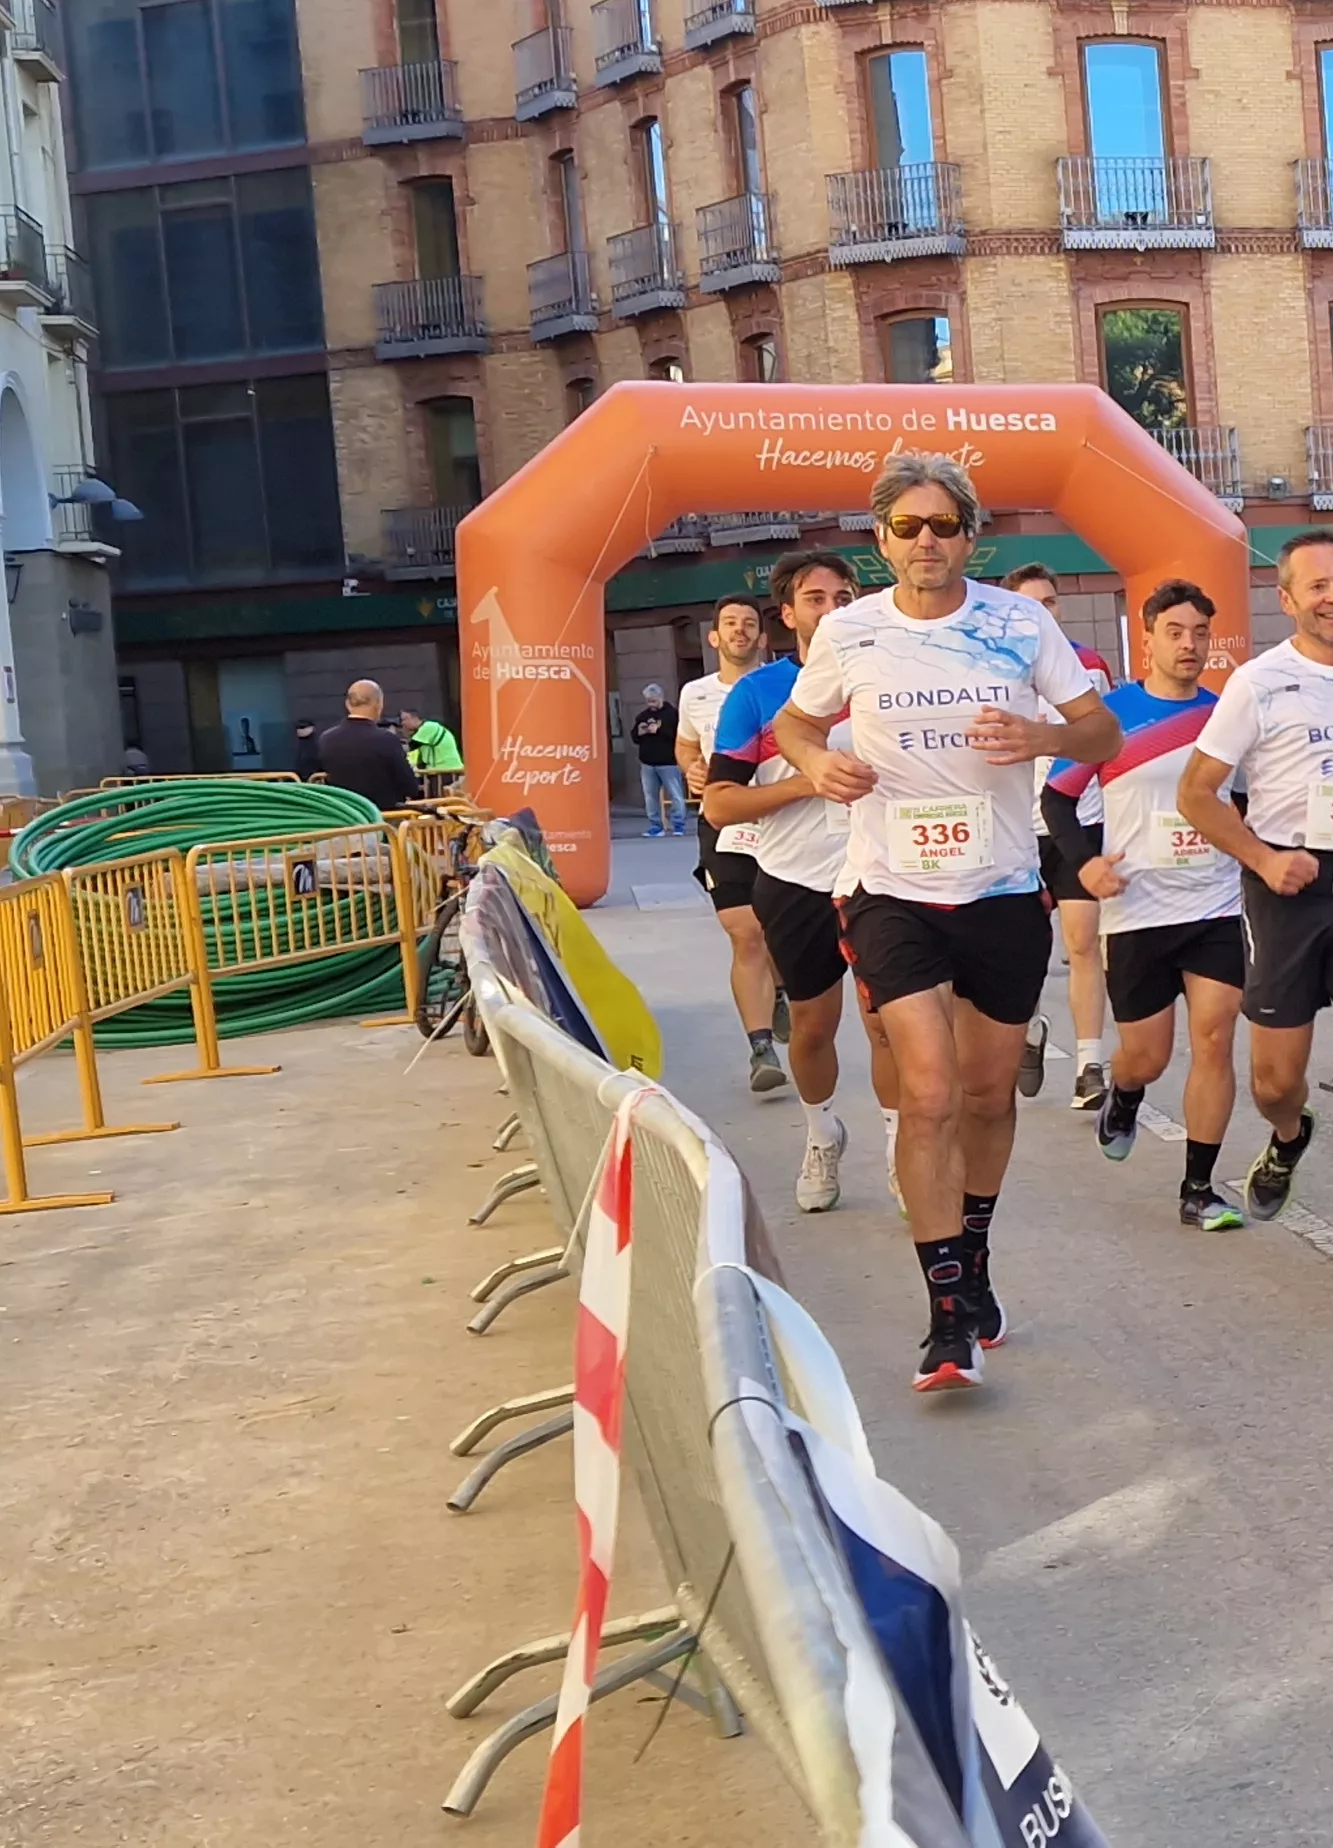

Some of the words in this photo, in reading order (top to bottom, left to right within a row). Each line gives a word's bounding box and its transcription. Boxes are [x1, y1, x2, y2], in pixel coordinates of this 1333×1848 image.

[680, 404, 893, 436] Ayuntamiento
[902, 407, 936, 432] de
[946, 407, 1057, 433] Huesca
[755, 437, 876, 473] Hacemos
[471, 641, 594, 662] Ayuntamiento
[473, 663, 491, 680] de
[496, 663, 571, 680] Huesca
[878, 685, 1011, 710] BONDALTI
[500, 735, 591, 762] Hacemos
[501, 759, 582, 796] deporte
[734, 830, 760, 845] 33
[911, 821, 971, 848] 336
[921, 858, 941, 871] 8K
